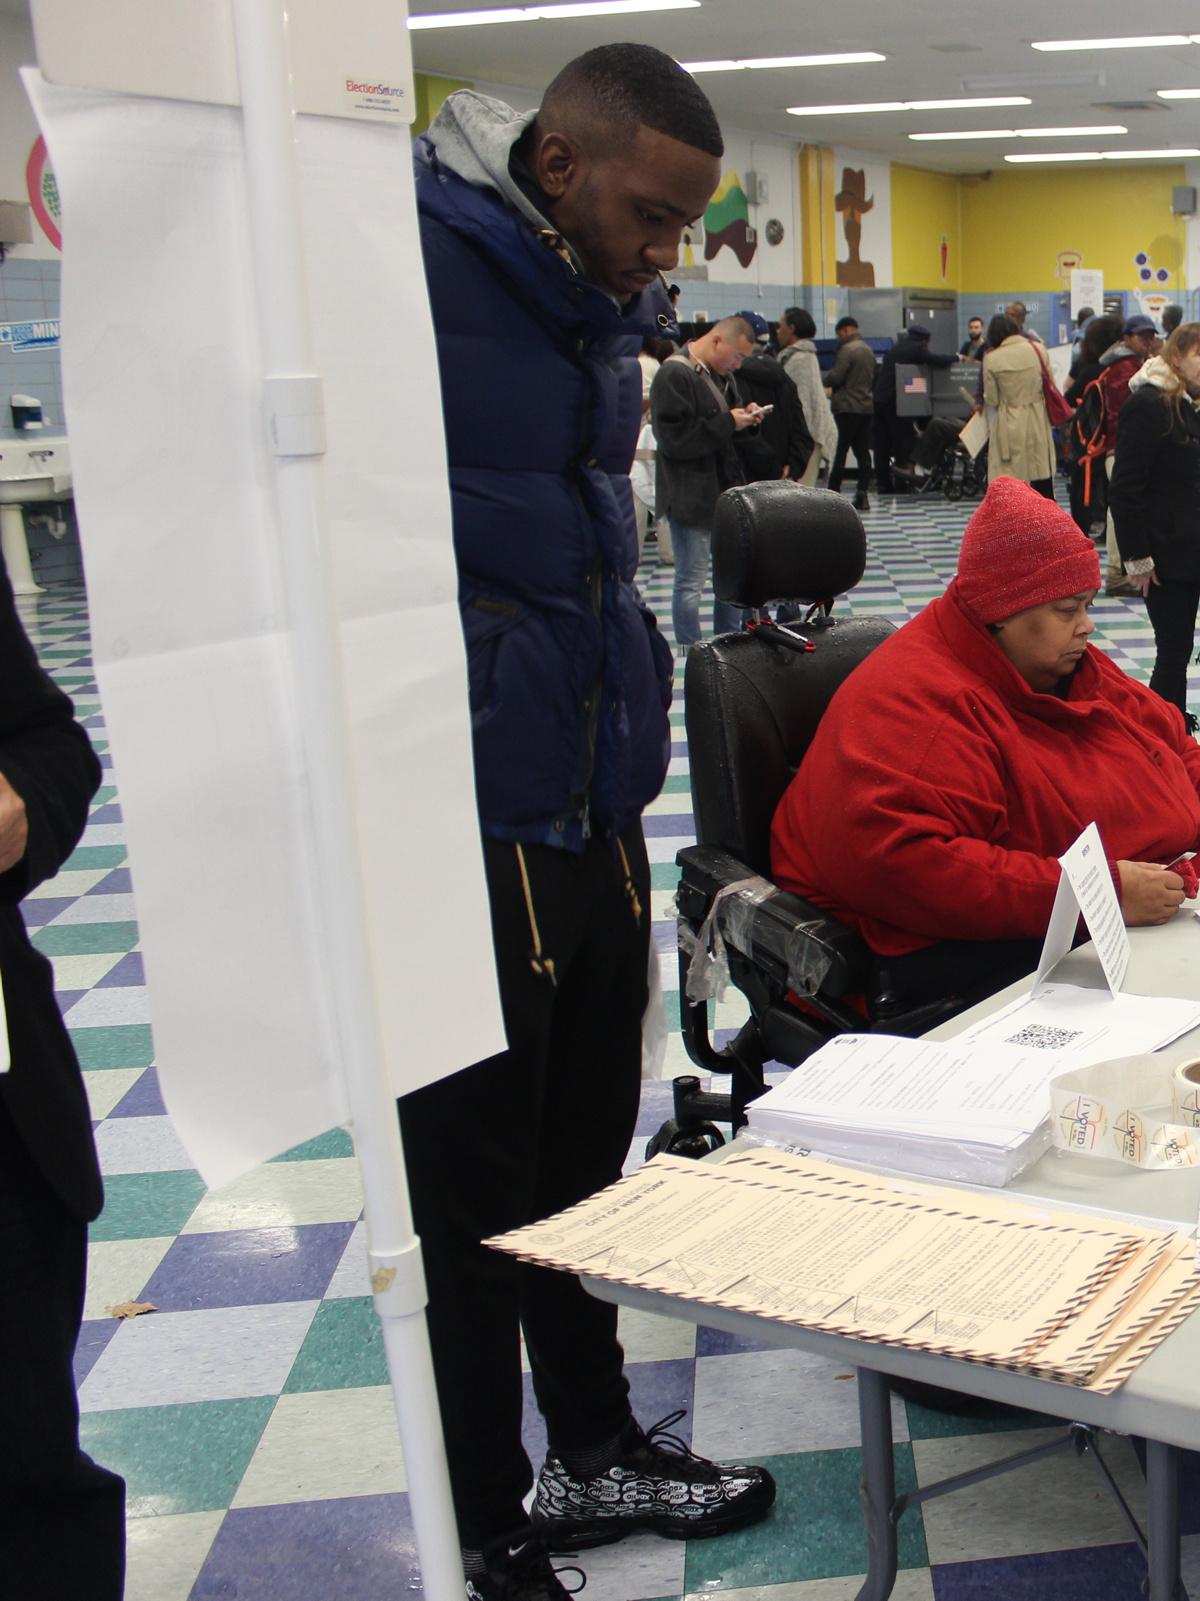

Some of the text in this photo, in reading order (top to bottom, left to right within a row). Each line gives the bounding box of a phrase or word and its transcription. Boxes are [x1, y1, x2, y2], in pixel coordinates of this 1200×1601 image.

[1077, 1112, 1090, 1145] VOTED
[585, 1180, 668, 1227] CITY OF NEW YORK
